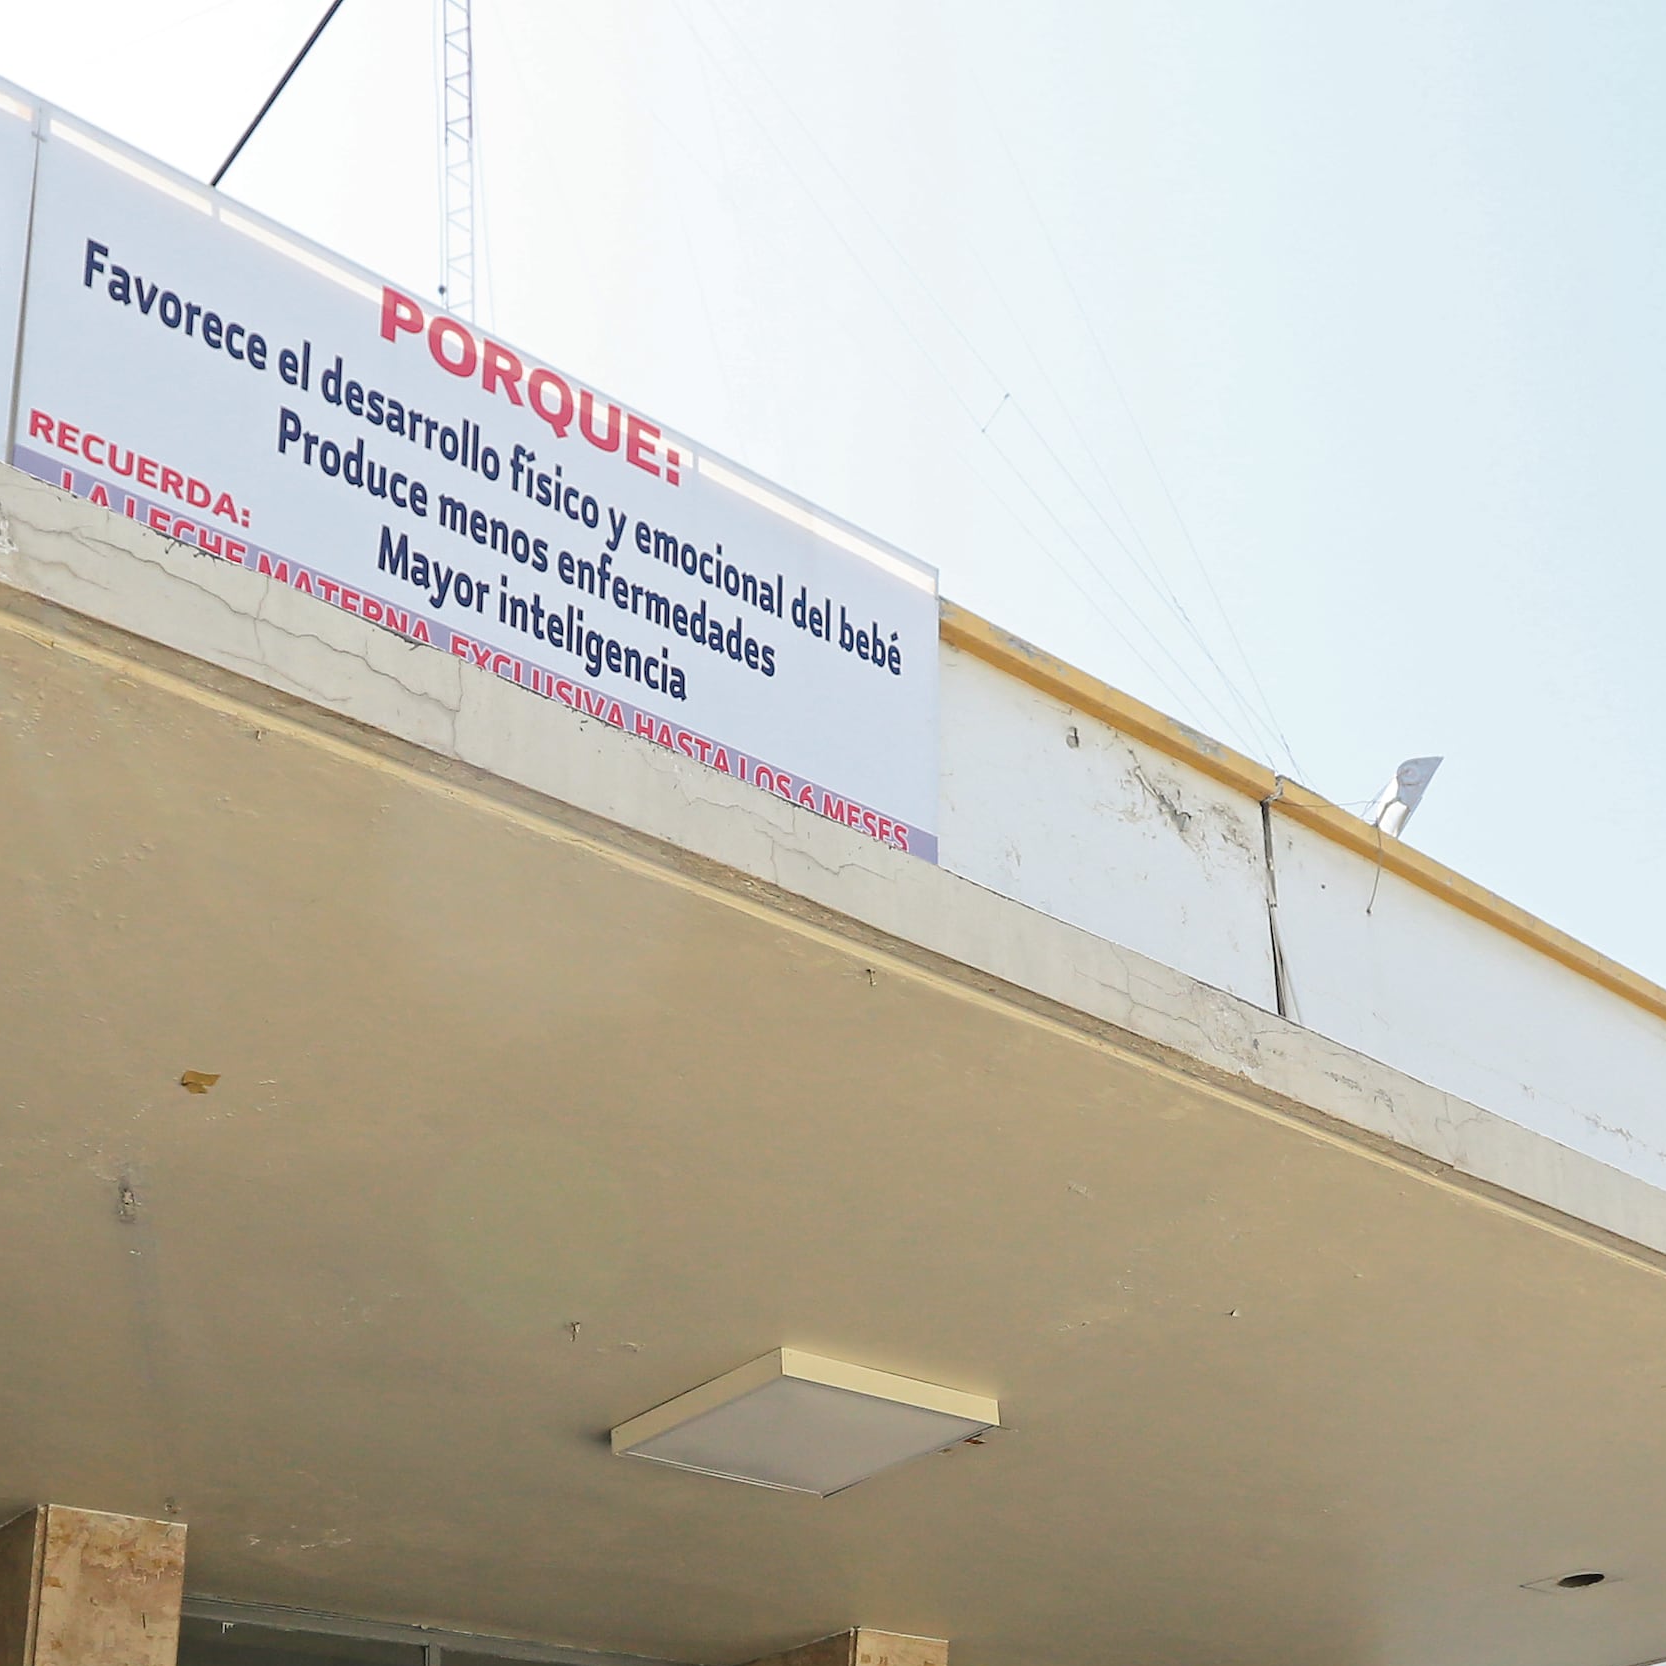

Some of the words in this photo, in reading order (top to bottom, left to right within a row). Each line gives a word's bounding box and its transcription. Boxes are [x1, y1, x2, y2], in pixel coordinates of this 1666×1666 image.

[28, 407, 251, 528] RECUERDA:
[83, 238, 267, 371] Favorece
[278, 340, 310, 392] el
[322, 356, 501, 482] desarrollo
[509, 440, 600, 529] físico
[608, 510, 627, 551] y
[635, 521, 784, 619] emocional
[791, 586, 833, 641] del
[839, 602, 903, 676] bebé
[380, 285, 681, 486] PORQUE:
[277, 406, 428, 517] Produce
[439, 493, 547, 574] menos
[558, 549, 777, 678] enfermedades
[377, 525, 490, 628] Mayor
[499, 574, 688, 701] inteligencia
[821, 796, 910, 852] MESES
